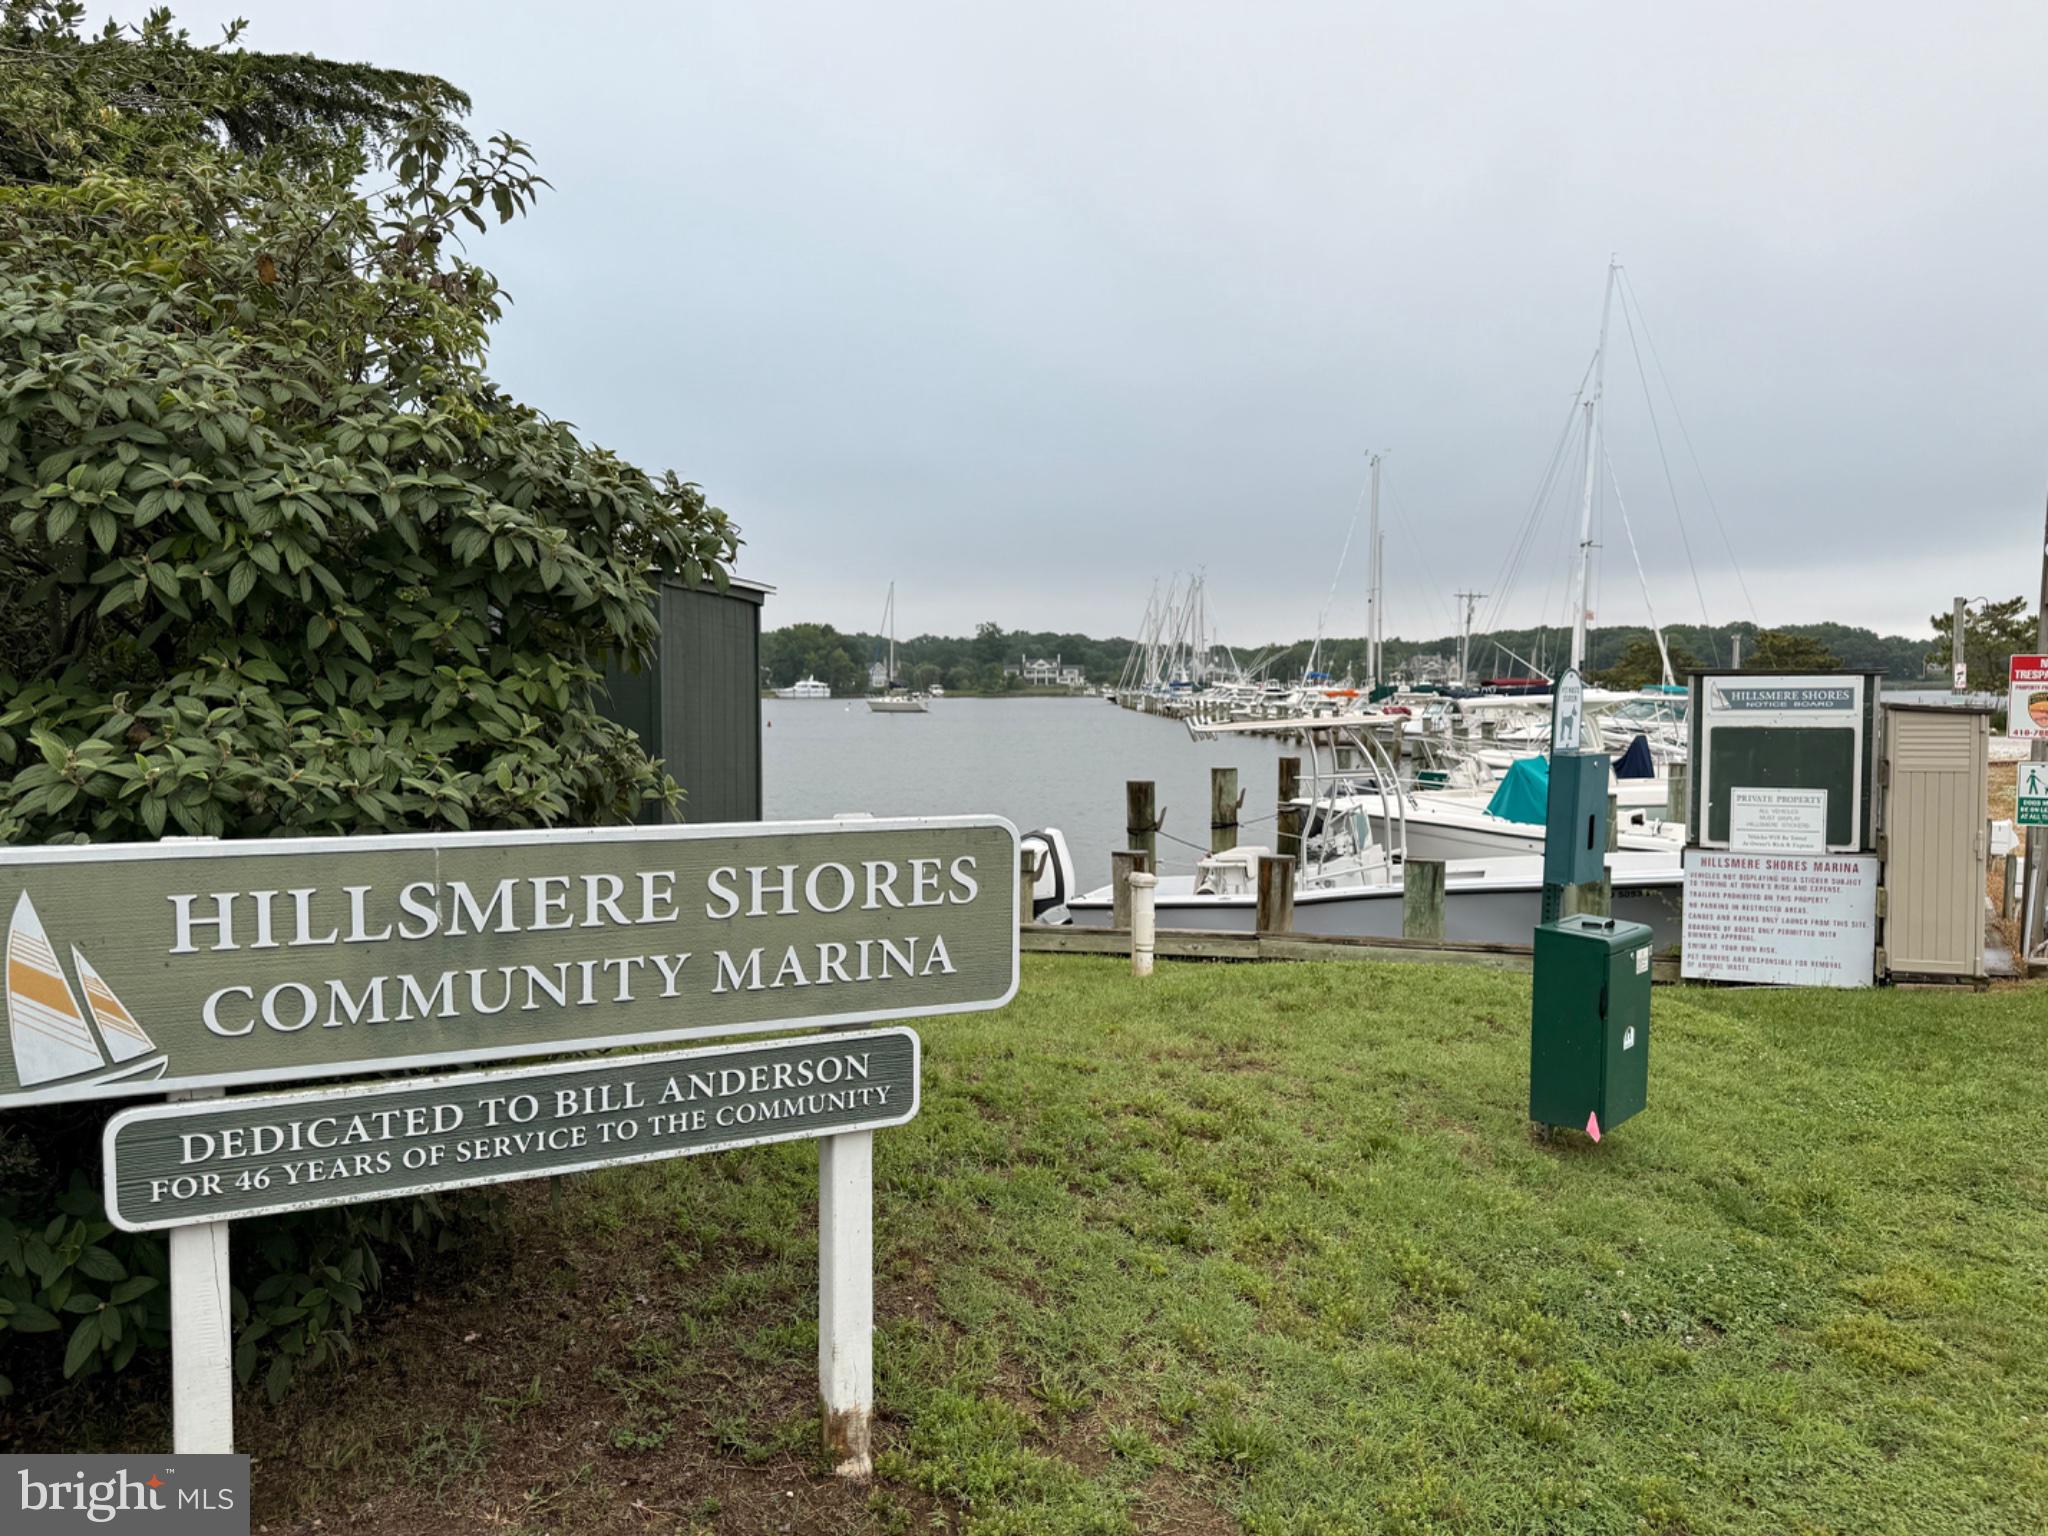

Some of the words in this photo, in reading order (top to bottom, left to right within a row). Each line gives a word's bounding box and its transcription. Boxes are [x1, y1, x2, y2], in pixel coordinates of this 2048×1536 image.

[1731, 691, 1799, 700] HILLSMERE
[1802, 690, 1850, 700] SHORES
[1736, 794, 1773, 803] PRIVATE
[1776, 795, 1823, 804] PROPERTY
[1700, 857, 1761, 870] HILLSMERE
[1766, 859, 1807, 872] SHORES
[1813, 861, 1859, 874] MARINA
[1690, 872, 1720, 880] VEHICLES
[1723, 873, 1736, 881] NOT
[1739, 874, 1778, 882] DISPLAYING
[1832, 878, 1862, 887] SUBJECT
[1701, 880, 1727, 888] TOWING
[1690, 891, 1720, 899] TRAILERS
[1723, 892, 1761, 901] PROHIBITED
[167, 870, 680, 954] HILLSMERE
[705, 855, 979, 919] SHORES
[1700, 902, 1729, 910] PARKING
[1742, 904, 1782, 913] RESTRICTED
[1688, 912, 1713, 921] CANOES
[1733, 915, 1759, 923] KAYAKS
[1833, 920, 1848, 928] THIS
[1734, 926, 1755, 934] BOATS
[1758, 927, 1774, 935] ONLY
[1777, 928, 1815, 937] PERMITTED
[1688, 942, 1707, 950] SWIM
[1721, 944, 1738, 952] YOUR
[1740, 945, 1757, 953] OWN
[1702, 954, 1729, 962] OWNERS
[1748, 957, 1792, 966] RESPONSIBLE
[1795, 959, 1808, 967] FOR
[202, 952, 692, 1037] COMMUNITY
[711, 934, 958, 995] MARINA
[179, 1103, 464, 1164] DEDICATED
[478, 1094, 539, 1128] TO
[554, 1082, 645, 1119] BILL
[660, 1053, 871, 1104] ANDERSON
[149, 1173, 224, 1203] FOR
[234, 1167, 271, 1192] 46
[281, 1151, 392, 1185] YEARS
[402, 1145, 446, 1170] OF
[455, 1126, 588, 1163] SERVICE
[597, 1119, 638, 1143] TO
[648, 1109, 707, 1137] THE
[715, 1084, 892, 1128] COMMUNITY
